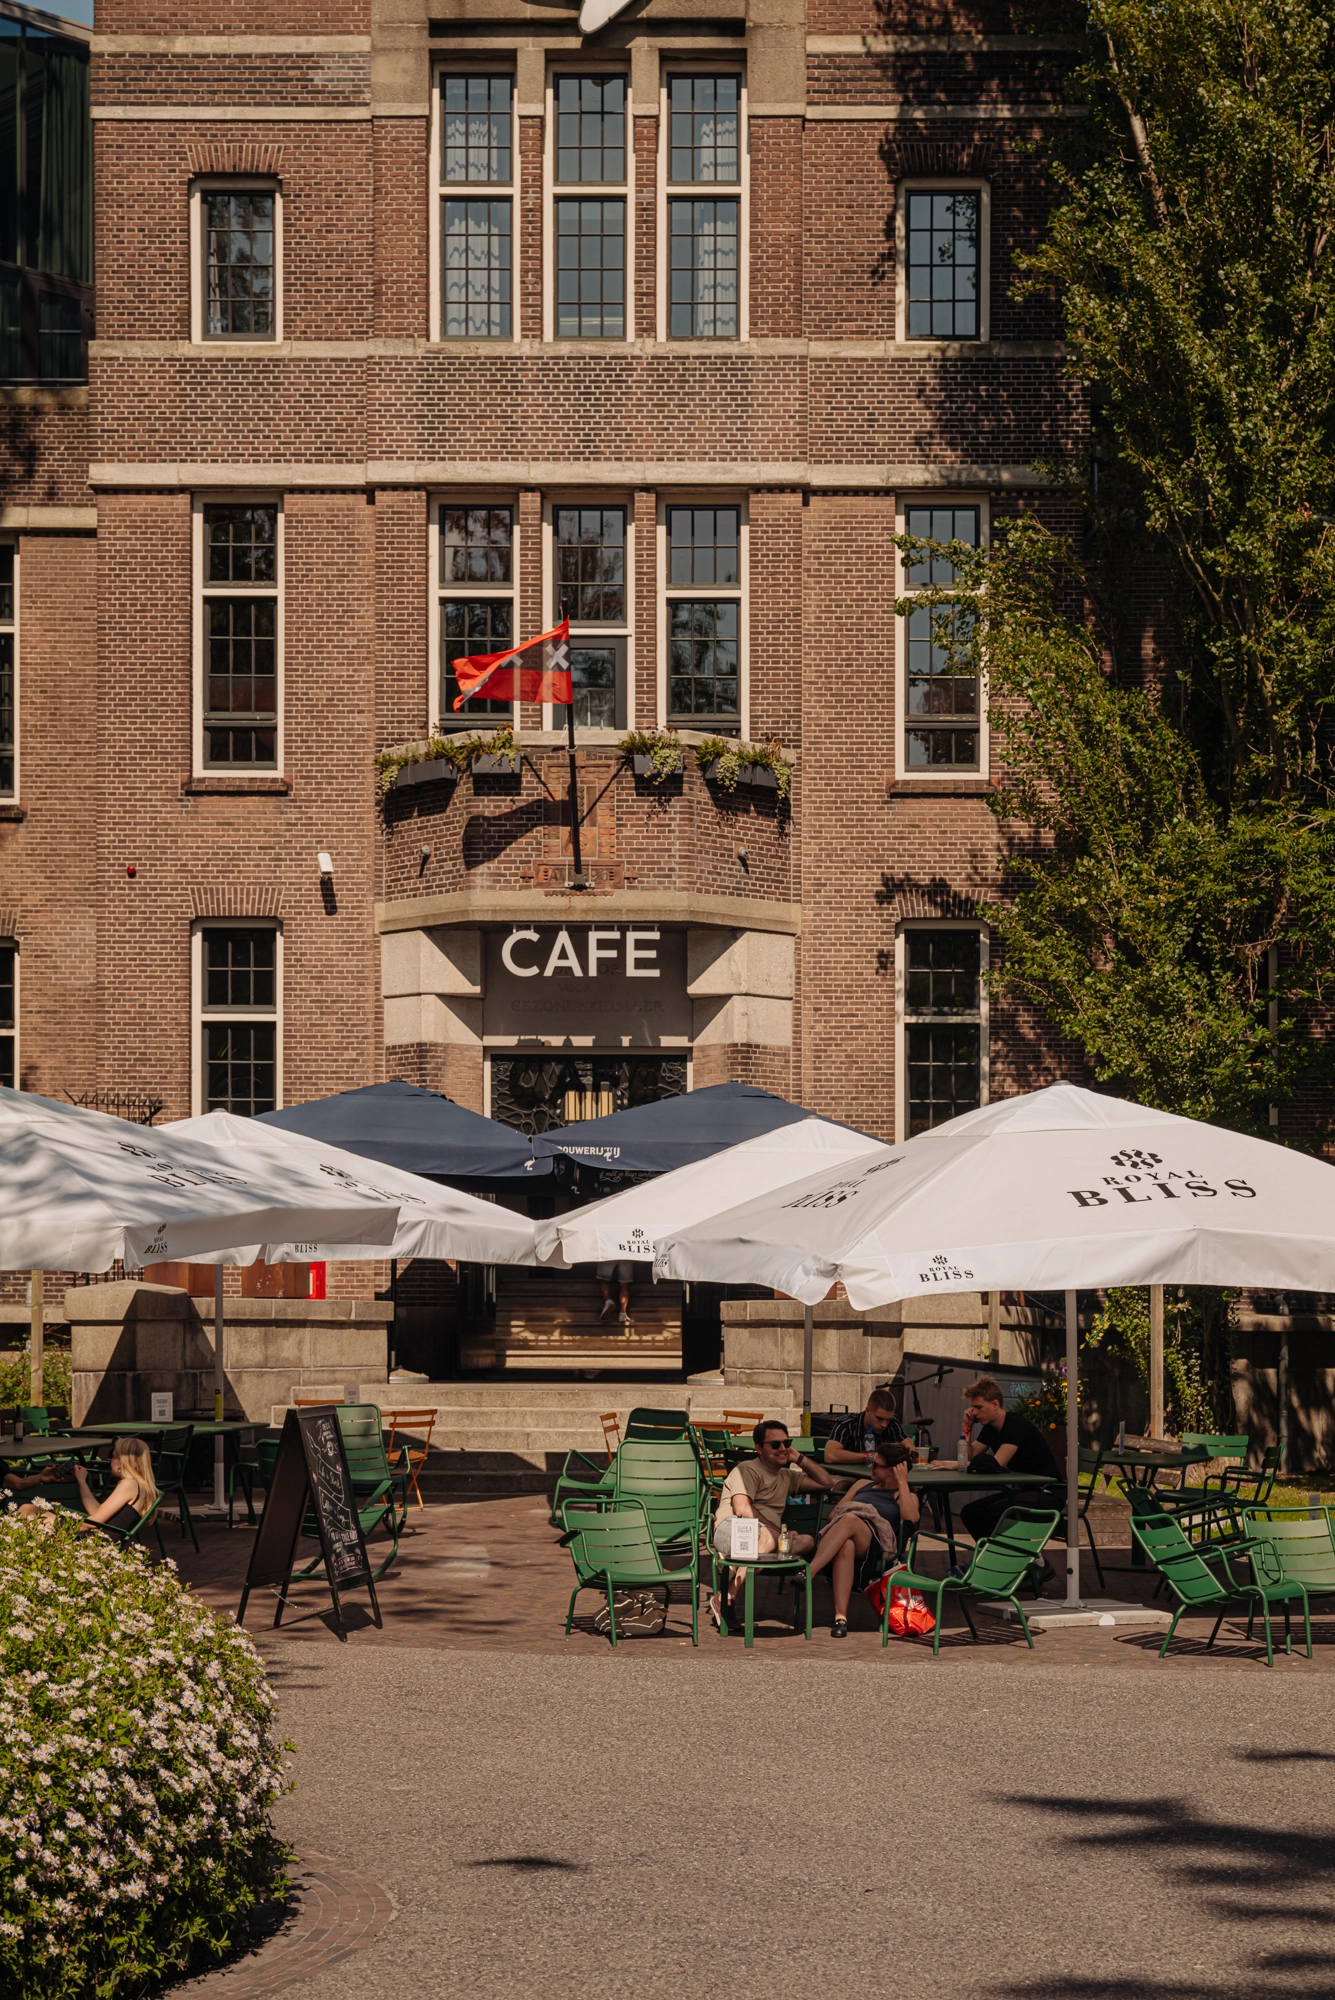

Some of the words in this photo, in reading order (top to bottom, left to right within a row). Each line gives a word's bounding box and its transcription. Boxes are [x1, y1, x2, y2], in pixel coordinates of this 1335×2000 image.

[501, 930, 661, 977] CAFE
[556, 1146, 603, 1155] OUWERIJ
[146, 1172, 248, 1188] BLISS
[1100, 1169, 1202, 1186] ROYAL
[367, 1187, 427, 1205] ISS
[1066, 1178, 1257, 1208] BLISS
[143, 1241, 168, 1255] BLISS
[294, 1243, 318, 1254] BLISS
[919, 1269, 975, 1283] BLISS
[928, 1264, 958, 1273] ROYAL
